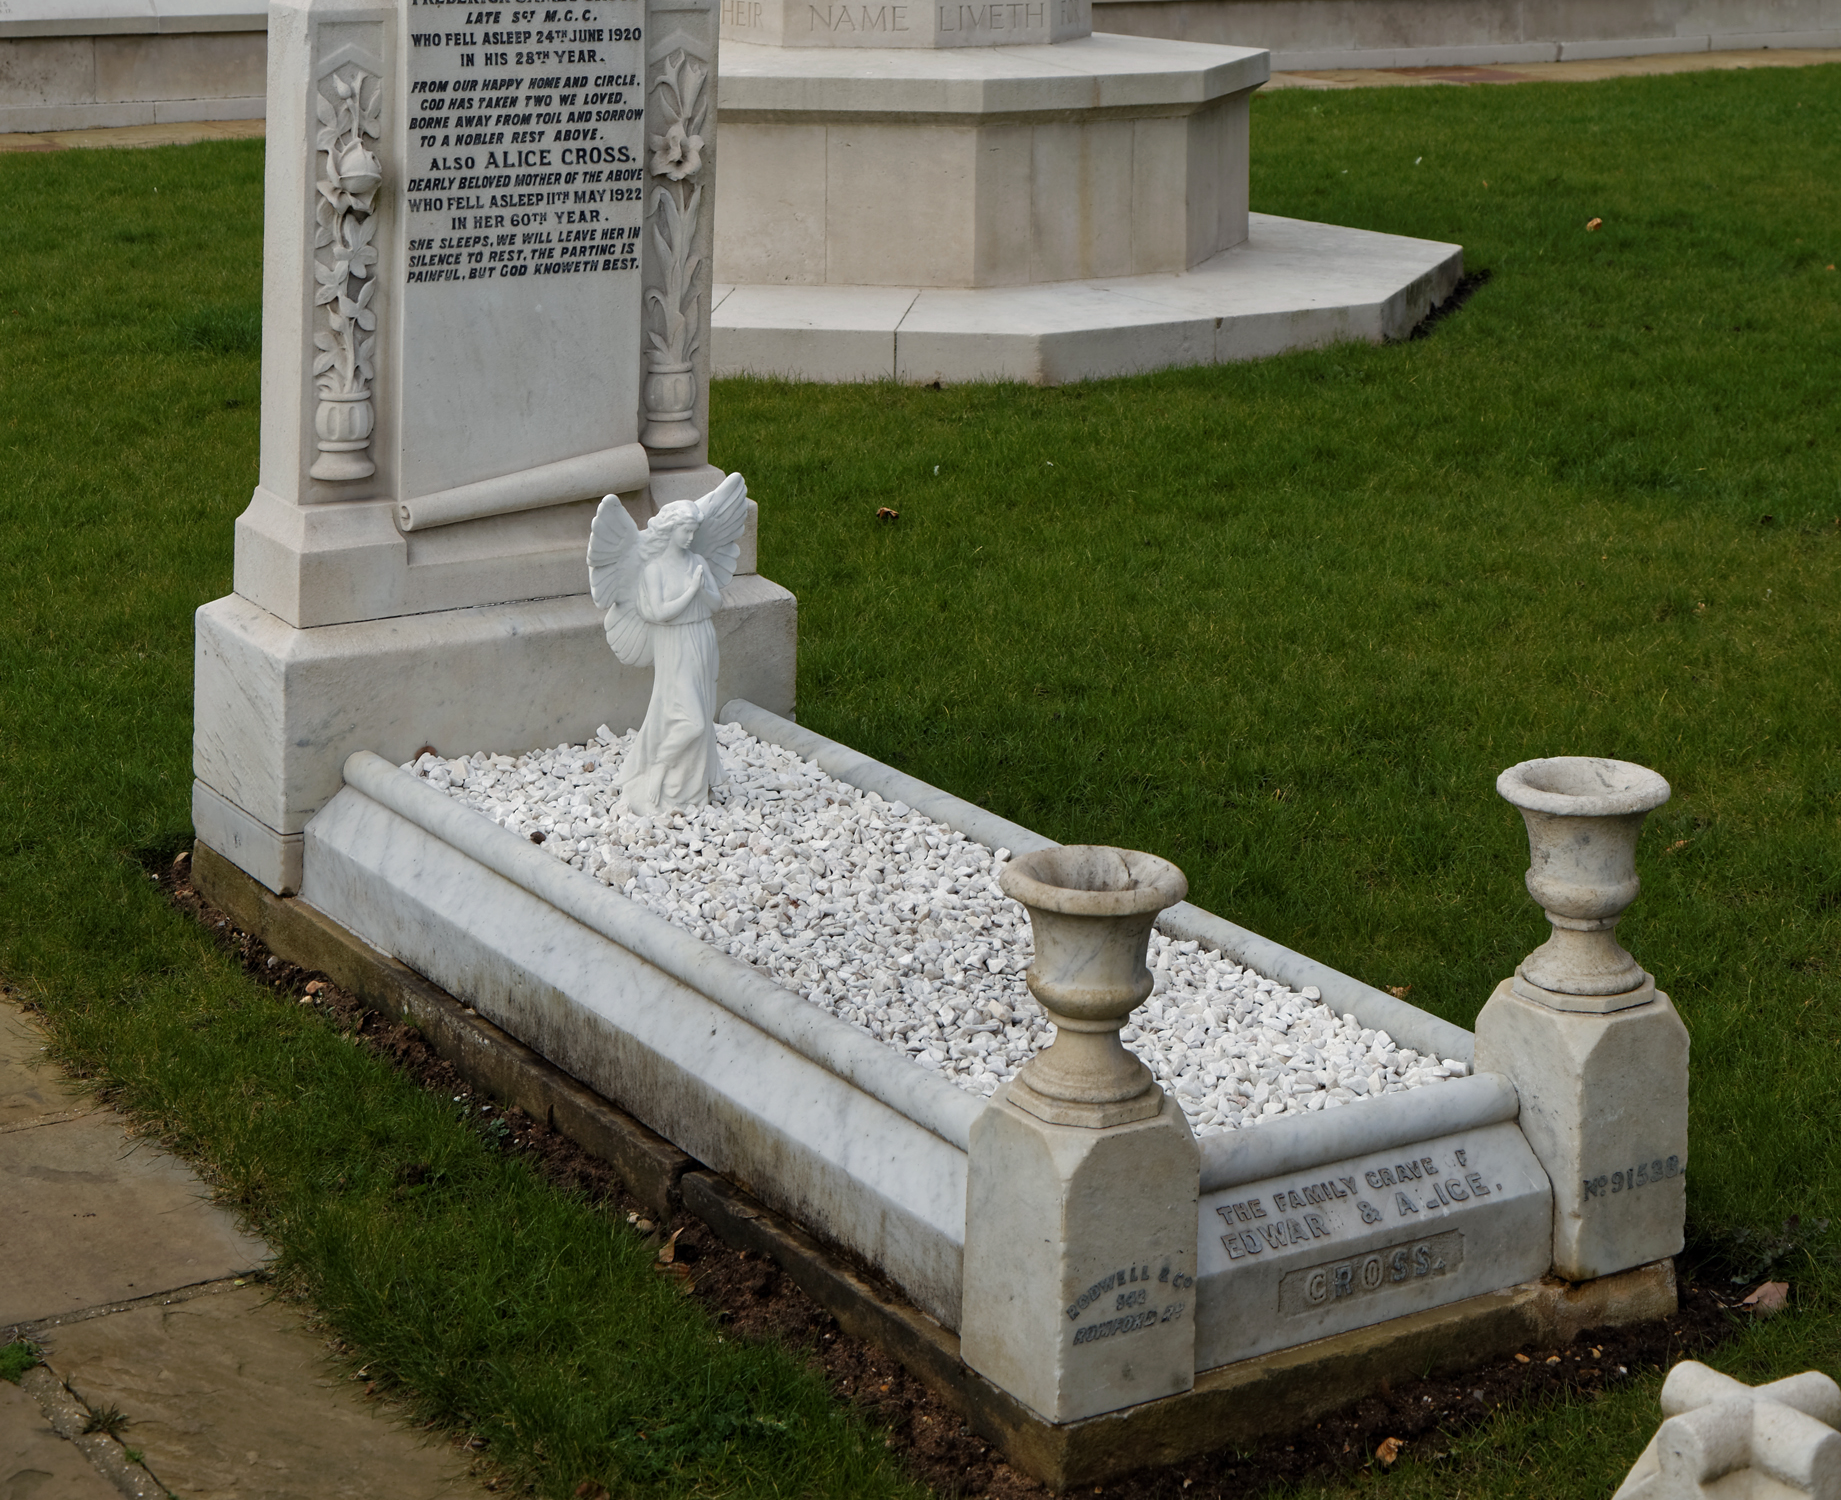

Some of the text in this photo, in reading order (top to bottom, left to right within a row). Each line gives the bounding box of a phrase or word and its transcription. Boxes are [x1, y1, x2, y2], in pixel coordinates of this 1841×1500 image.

[466, 11, 501, 24] LATE
[809, 6, 909, 31] NAME
[939, 3, 1044, 31] LIVETH
[411, 33, 441, 47] WHO
[445, 32, 477, 46] FELL
[482, 31, 531, 46] ASLEEP
[569, 29, 603, 42] JUNE
[609, 28, 642, 41] 1920
[461, 54, 475, 67] IN
[485, 53, 508, 65] HIS
[411, 81, 448, 93] FROM
[453, 80, 478, 92] OUR
[482, 78, 523, 91] HAPPY
[528, 77, 560, 89] HOME
[563, 77, 588, 88] AND
[421, 99, 444, 111] GOD
[448, 98, 474, 109] HAS
[477, 96, 517, 108] TAKEN
[525, 95, 552, 107] TWO
[559, 94, 576, 106] WE
[409, 109, 643, 129] BORNE AWAY FROM TOIL AND SORROW
[420, 136, 436, 147] TO
[441, 135, 450, 146] A
[455, 133, 504, 145] NOBLER
[511, 131, 545, 143] REST
[430, 157, 475, 171] ALSO
[485, 150, 552, 169] ALICE
[408, 169, 643, 192] DEARLY BELOVED MOTHER OF THE ABOVE
[408, 199, 443, 212] WHO
[447, 197, 484, 210] FELL
[489, 193, 543, 208] ASLEEP
[574, 190, 605, 204] MAY
[610, 188, 642, 201] 1922
[452, 217, 467, 229] IN
[474, 215, 504, 228] HER
[408, 239, 434, 250] SHE
[496, 235, 516, 246] WE
[522, 232, 552, 244] WILL
[558, 229, 596, 242] LEAVE
[601, 228, 624, 240] HER
[628, 227, 640, 239] IN
[409, 254, 461, 267] SILENCE
[467, 251, 483, 264] TO
[530, 248, 554, 259] THE
[560, 244, 615, 258] PARTING
[620, 243, 635, 254] IS
[469, 267, 496, 279] BUT
[500, 265, 527, 277] GOD
[533, 261, 598, 275] KNOWETH
[1216, 1198, 1267, 1225] THE
[1273, 1177, 1358, 1212] FAMILY
[1365, 1157, 1438, 1188] GRAVE
[1220, 1213, 1344, 1260] EDWAR
[1357, 1201, 1383, 1224] &
[1066, 1265, 1151, 1321] RODWELL
[1158, 1266, 1171, 1283] &
[1073, 1310, 1158, 1346] ROMFORD
